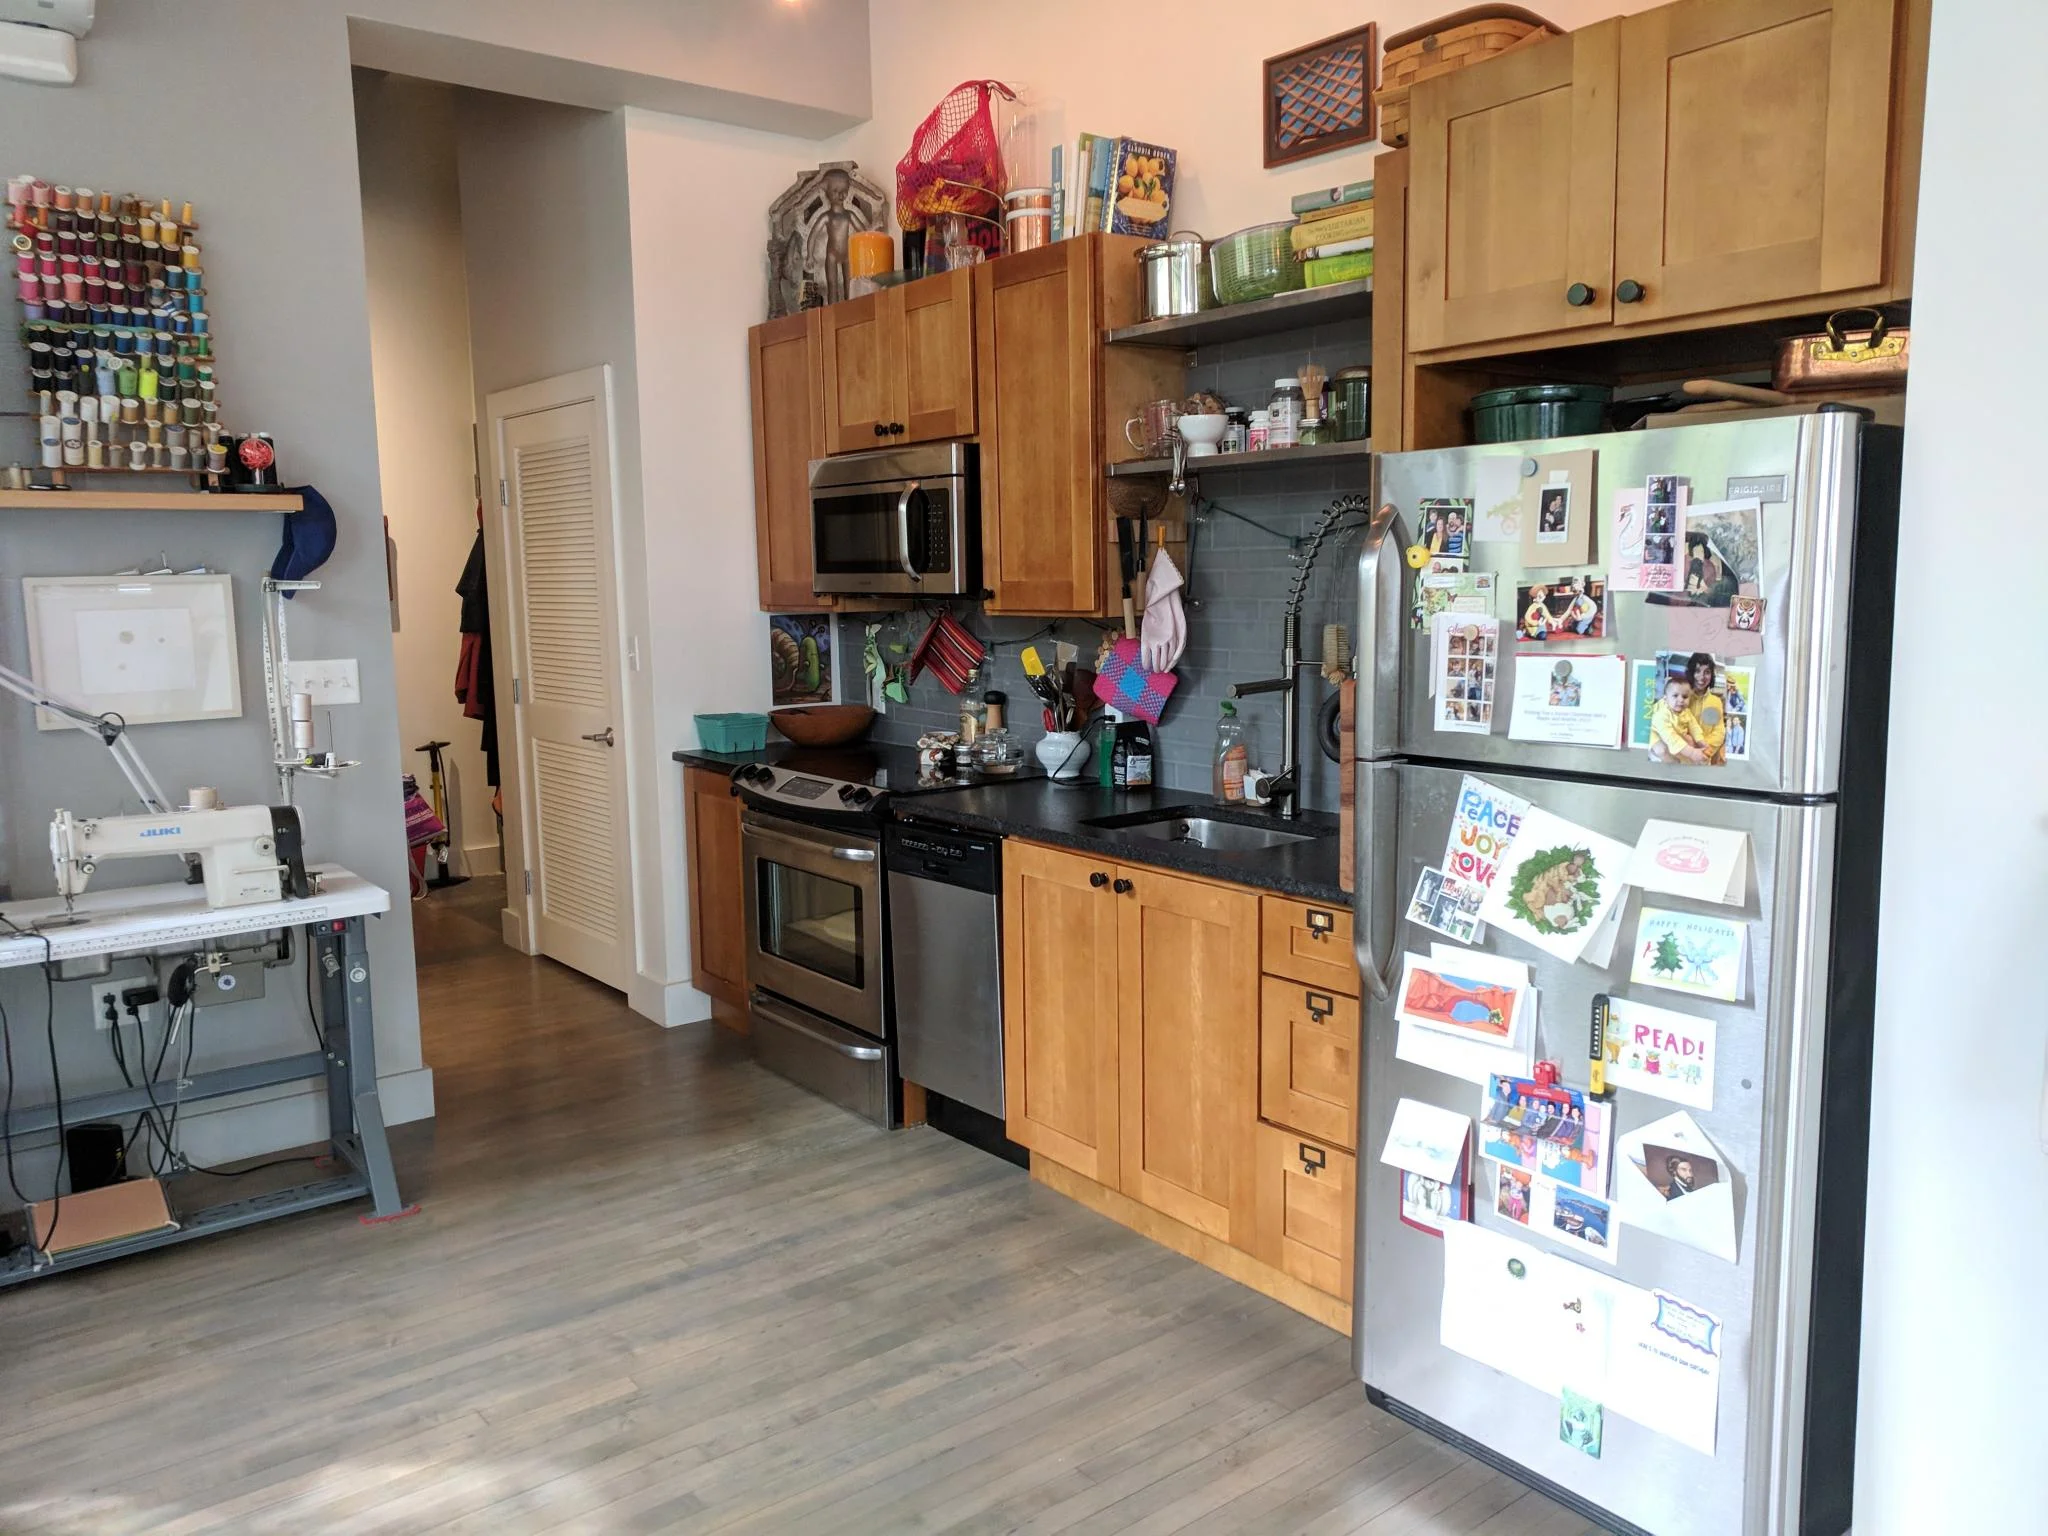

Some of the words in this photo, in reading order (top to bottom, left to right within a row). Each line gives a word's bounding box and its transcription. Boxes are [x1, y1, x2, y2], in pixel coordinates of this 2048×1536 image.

[1053, 181, 1061, 231] PEPIN
[139, 826, 181, 837] JUKI
[1460, 825, 1510, 861] JOY
[1634, 1023, 1705, 1061] READ!
